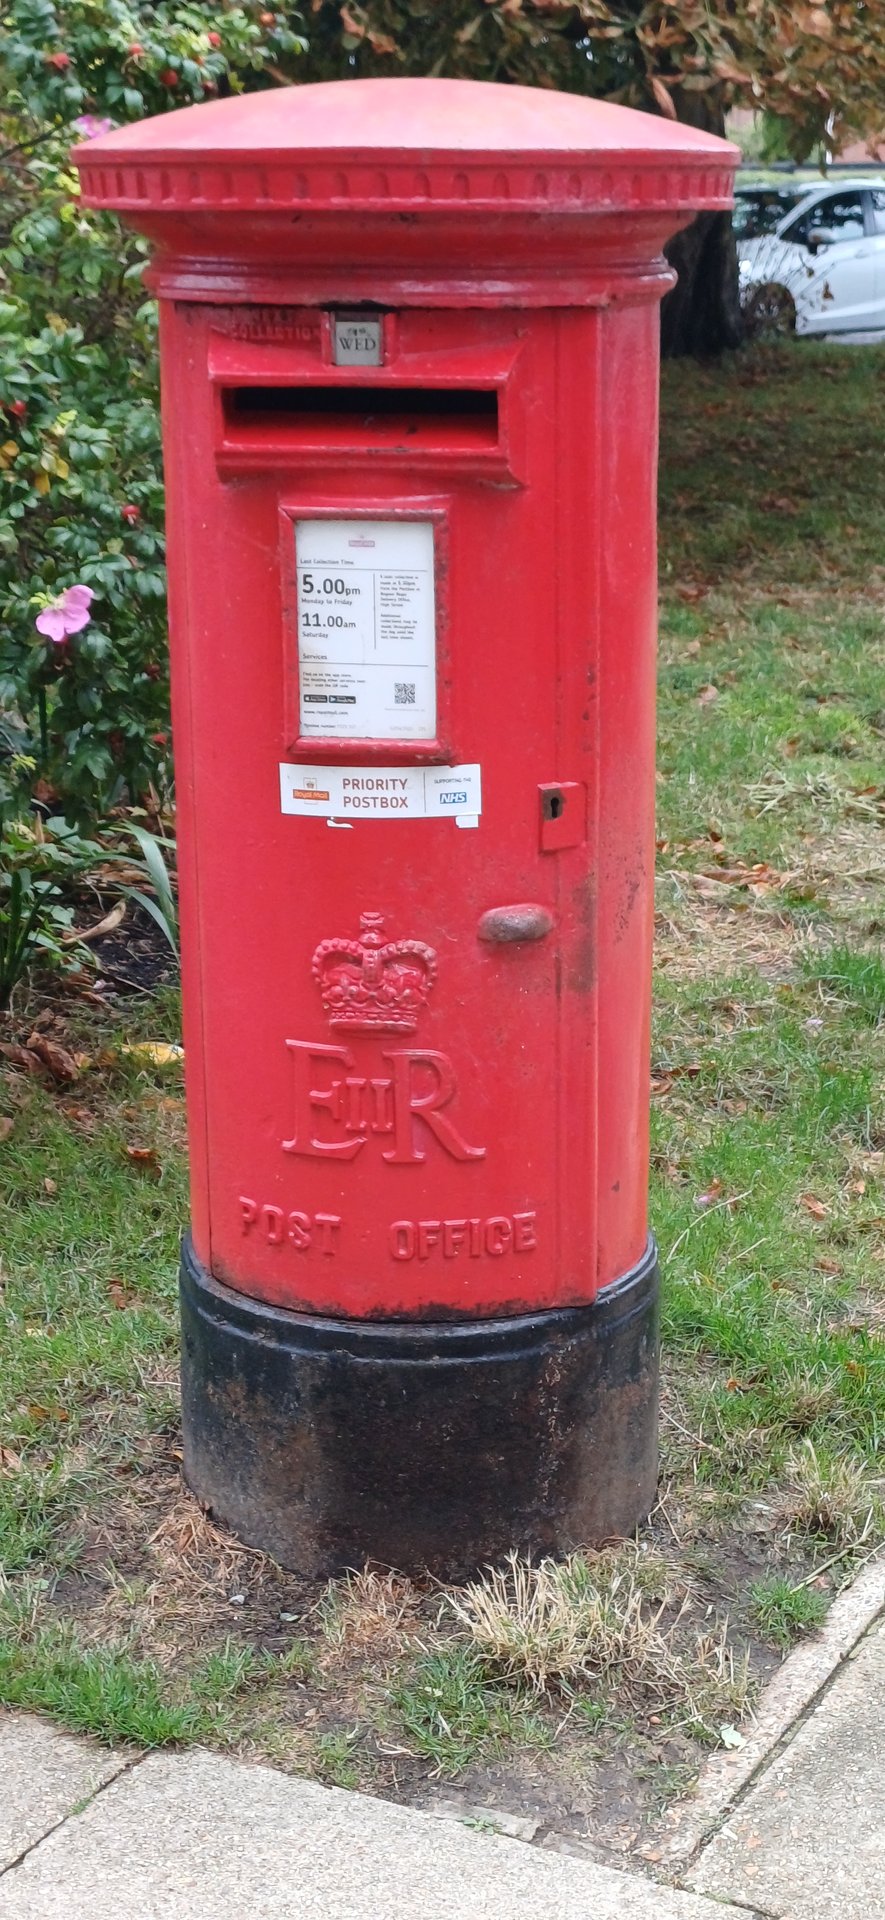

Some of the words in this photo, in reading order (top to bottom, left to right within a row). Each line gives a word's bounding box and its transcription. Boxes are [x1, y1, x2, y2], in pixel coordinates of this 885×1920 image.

[339, 337, 377, 351] WED
[302, 574, 361, 597] 5.00pm
[301, 597, 324, 606] Monday
[334, 599, 353, 607] Friday
[302, 612, 357, 628] 11.00am
[302, 631, 329, 639] Saturday
[342, 778, 409, 791] PRIORITY
[294, 790, 313, 801] Royal
[313, 790, 328, 800] Mail
[441, 792, 466, 804] NHS
[343, 796, 409, 809] POSTBOX
[239, 1195, 342, 1256] POST
[389, 1210, 537, 1261] OFFICE
